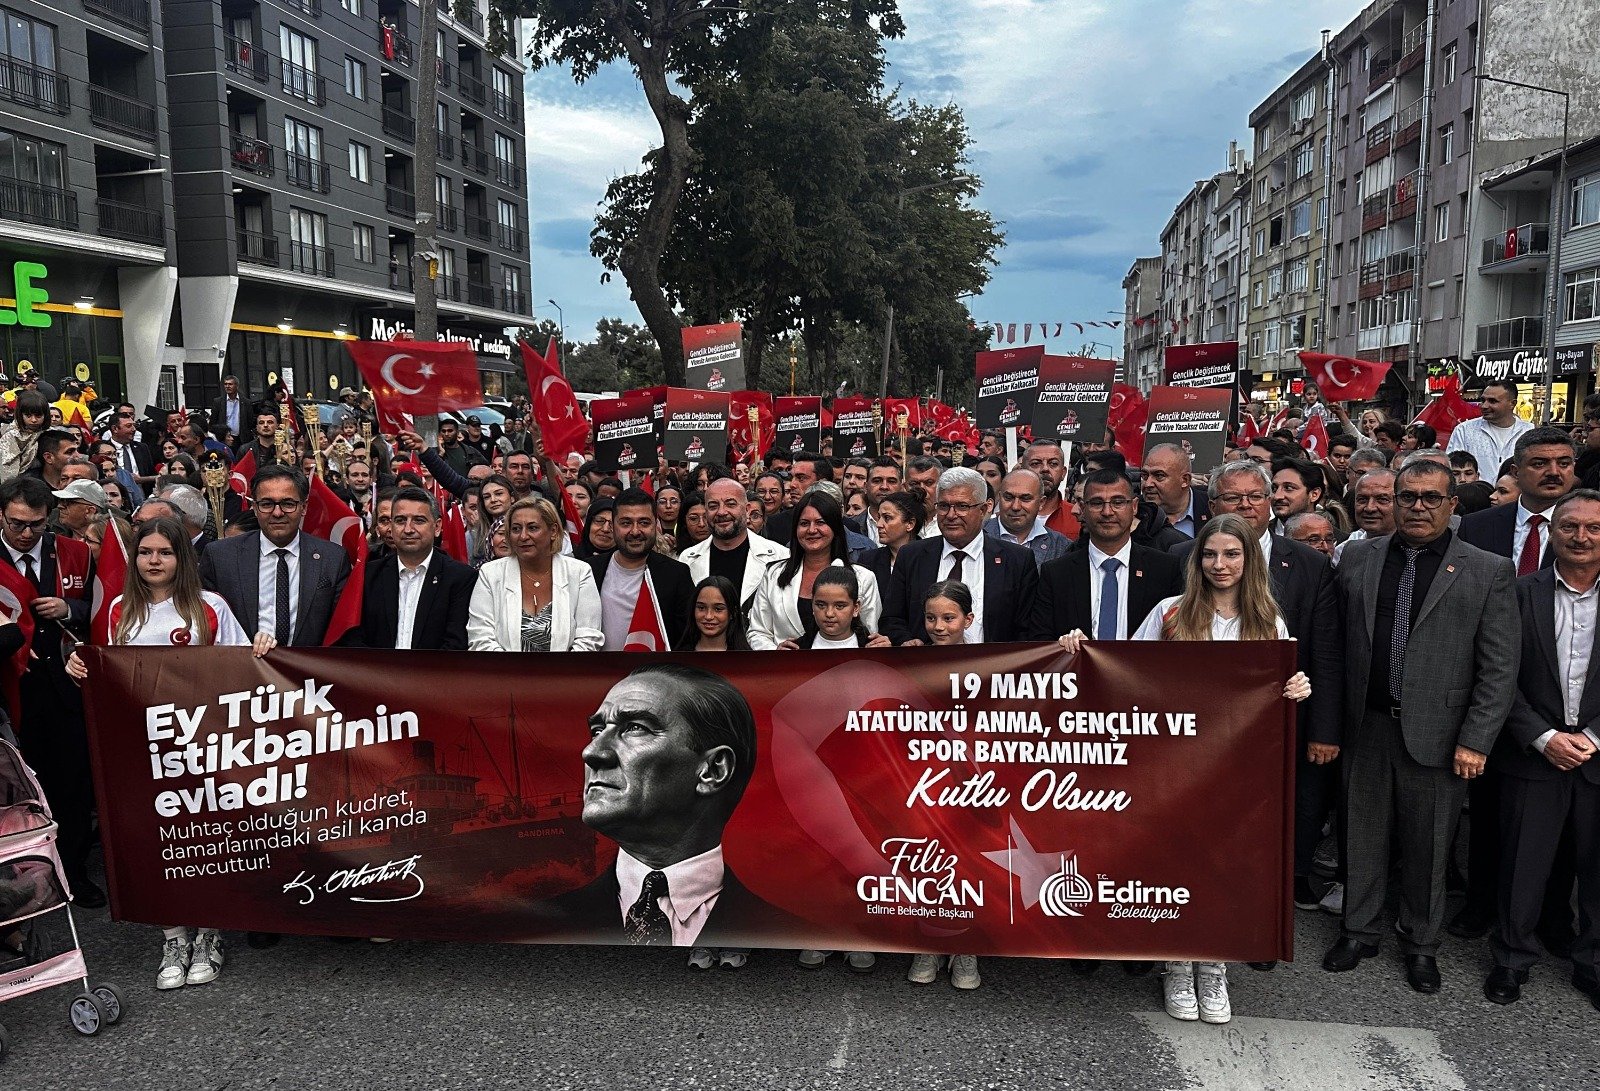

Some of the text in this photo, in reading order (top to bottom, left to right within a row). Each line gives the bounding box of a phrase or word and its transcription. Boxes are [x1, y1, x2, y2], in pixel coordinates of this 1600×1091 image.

[0, 261, 52, 328] E
[483, 339, 510, 360] wedding
[1556, 350, 1584, 361] Bay-Bayan
[982, 367, 1038, 386] Gençlik Değiştirecek
[1172, 362, 1231, 380] Gençlik Değiştirecek
[1560, 361, 1578, 373] Çocuk
[1044, 382, 1105, 393] Gençlik Değiştirecek
[1212, 373, 1232, 384] Olacak!
[1040, 392, 1106, 402] Demokrasi Gelecek!
[600, 415, 649, 431] Gençlik Değiştirecek
[672, 412, 691, 420] Gençlik
[691, 411, 723, 421] Değiştirecek
[1156, 410, 1221, 421] Gençlik Değiştirecek
[1154, 422, 1220, 432] Türkiye Yasaksız Olacak!
[949, 672, 1078, 700] 19 MAYIS
[145, 678, 336, 746] Ey Türk
[845, 704, 1197, 741] ATATÜRK'Ü ANMA, GENÇLİK VE
[149, 704, 419, 780] istikbalinin
[907, 739, 1128, 766] SPOR BAYRAMIMIZ
[154, 762, 309, 818] evladı!
[906, 767, 1132, 812] Kutlu Olsun
[159, 789, 413, 842] Muhtaç olduğun kudret,
[161, 807, 428, 861] damarlarındaki asil kanda
[517, 827, 566, 839] BANDIRMA
[164, 854, 272, 880] mevcuttur!
[881, 837, 959, 893] Filiz
[856, 875, 985, 907] GENCAN
[1098, 879, 1191, 905] Edirne
[866, 904, 974, 920] Edirne Belediye Başkanı
[1107, 903, 1181, 923] Belediyesi
